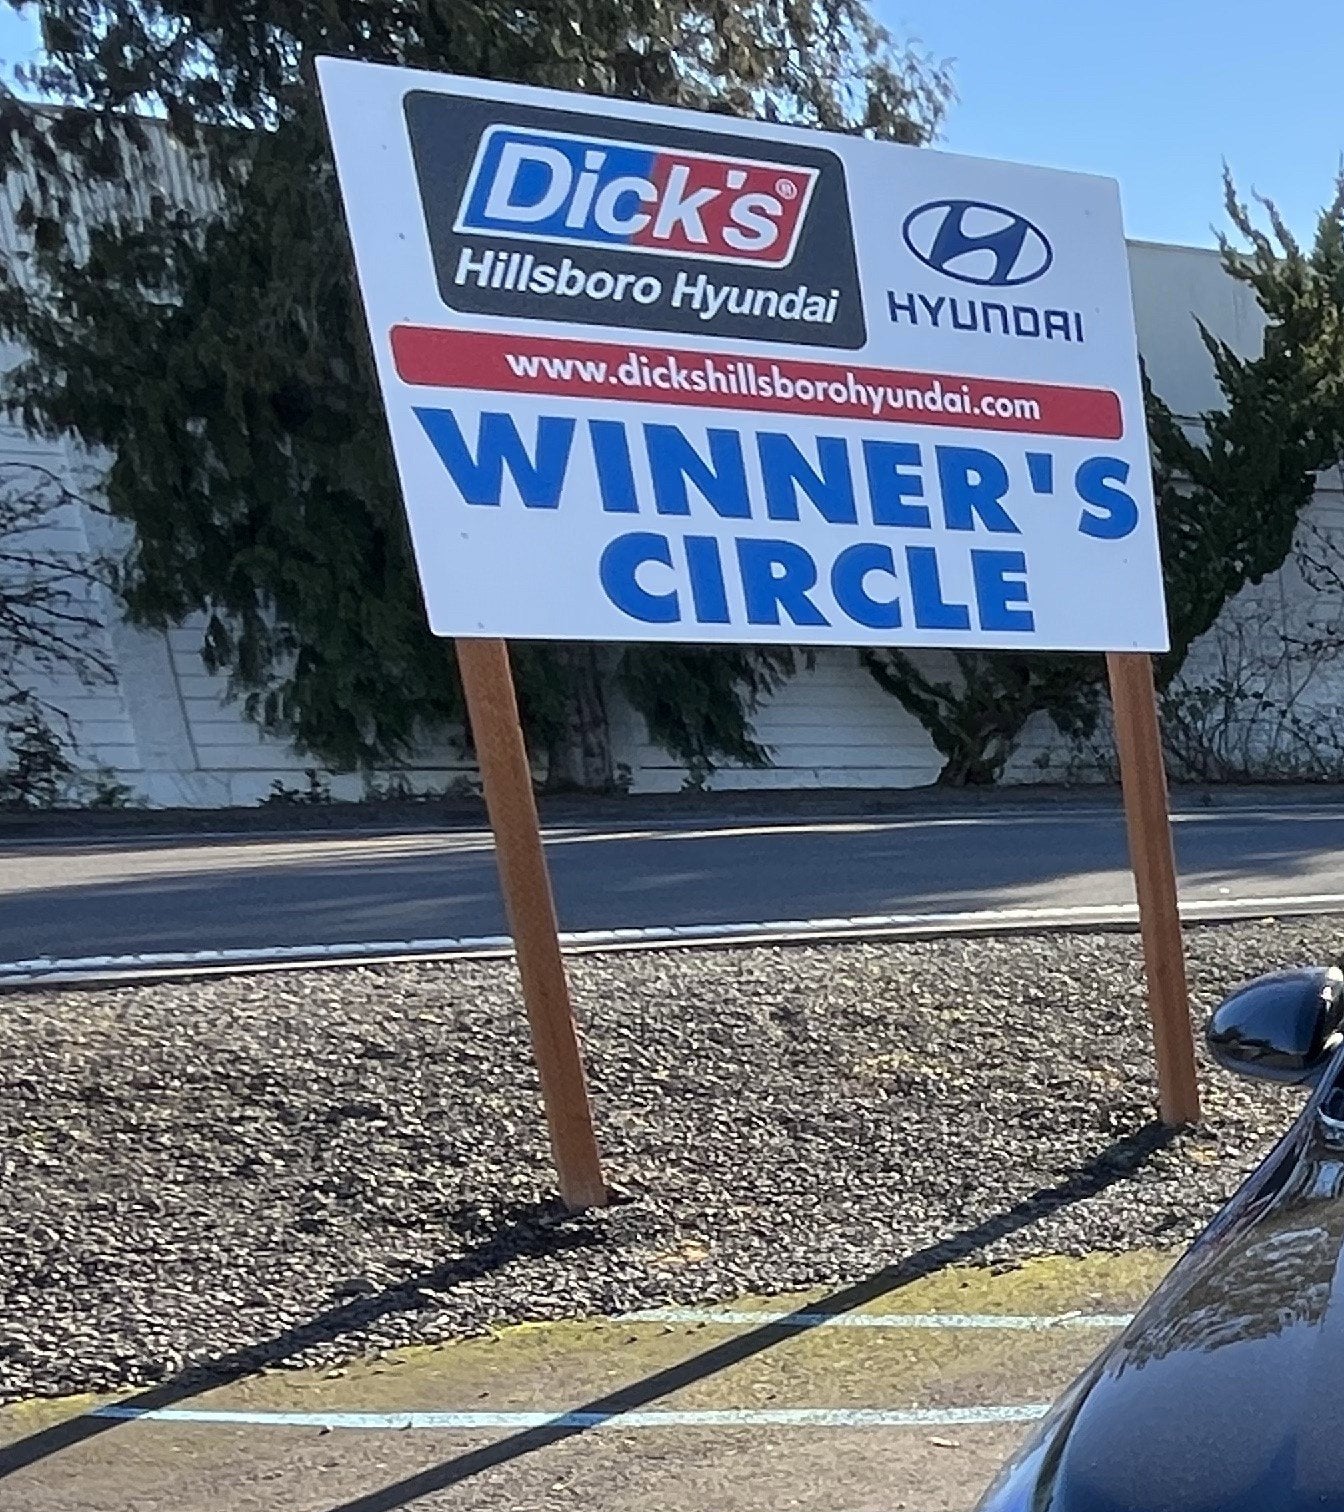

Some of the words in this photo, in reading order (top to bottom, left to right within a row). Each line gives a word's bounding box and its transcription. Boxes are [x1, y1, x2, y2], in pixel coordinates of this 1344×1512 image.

[484, 142, 783, 251] Dick's
[455, 247, 662, 304] Hillsboro
[671, 270, 840, 323] Hyundai
[887, 291, 1084, 343] HYUNDAI
[505, 349, 1041, 421] www.dickshillsborohyundai.com
[411, 405, 1139, 539] WINNER'S
[600, 530, 1036, 633] CIRCLE
